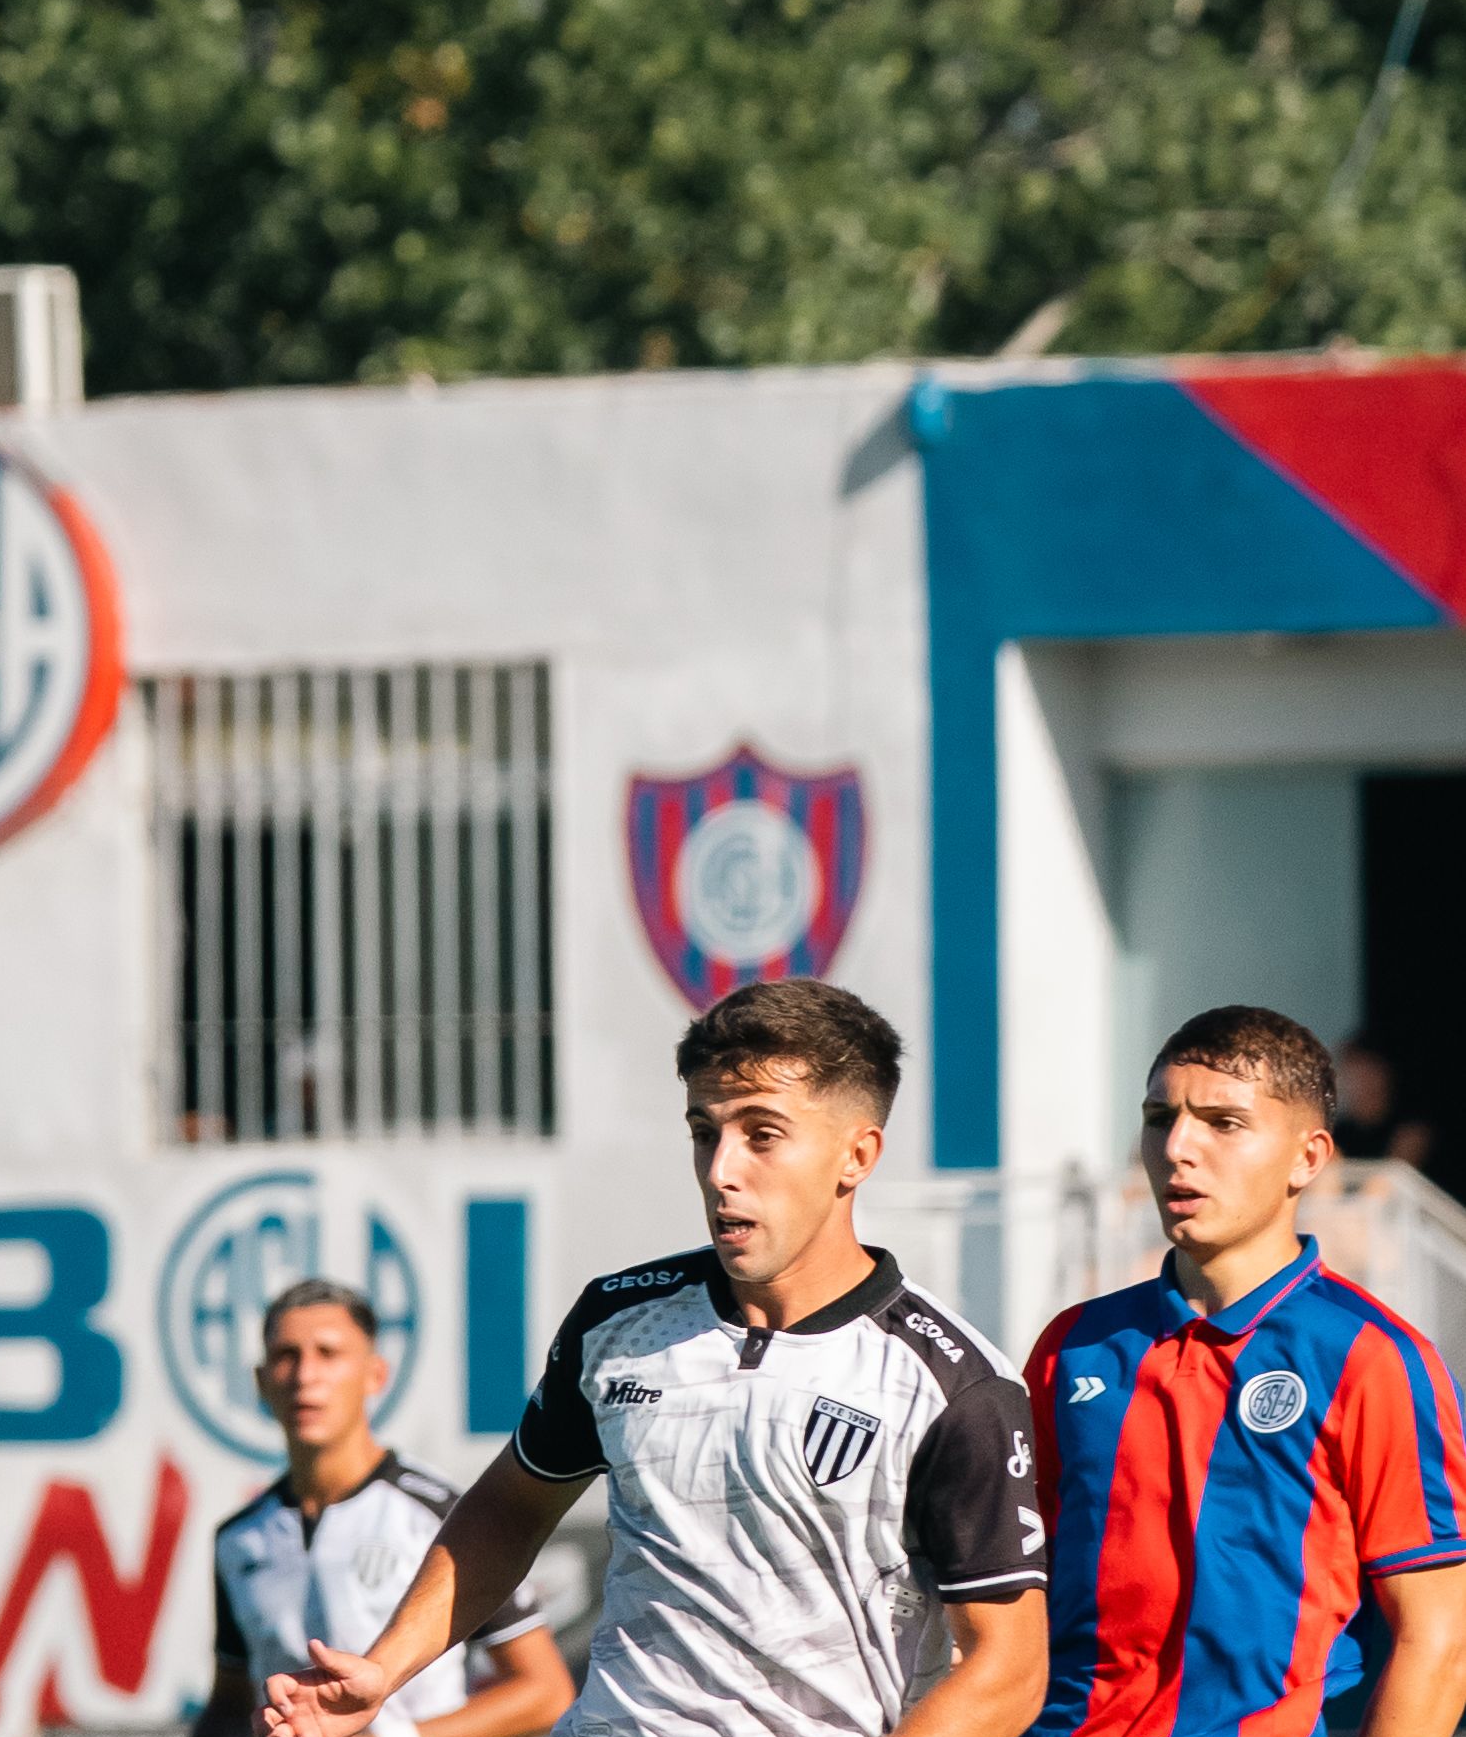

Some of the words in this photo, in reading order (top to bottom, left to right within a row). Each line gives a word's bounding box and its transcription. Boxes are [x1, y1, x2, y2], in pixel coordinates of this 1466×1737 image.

[905, 1312, 965, 1364] CEOSA
[602, 1379, 663, 1405] Mitre
[847, 1411, 873, 1428] 1908
